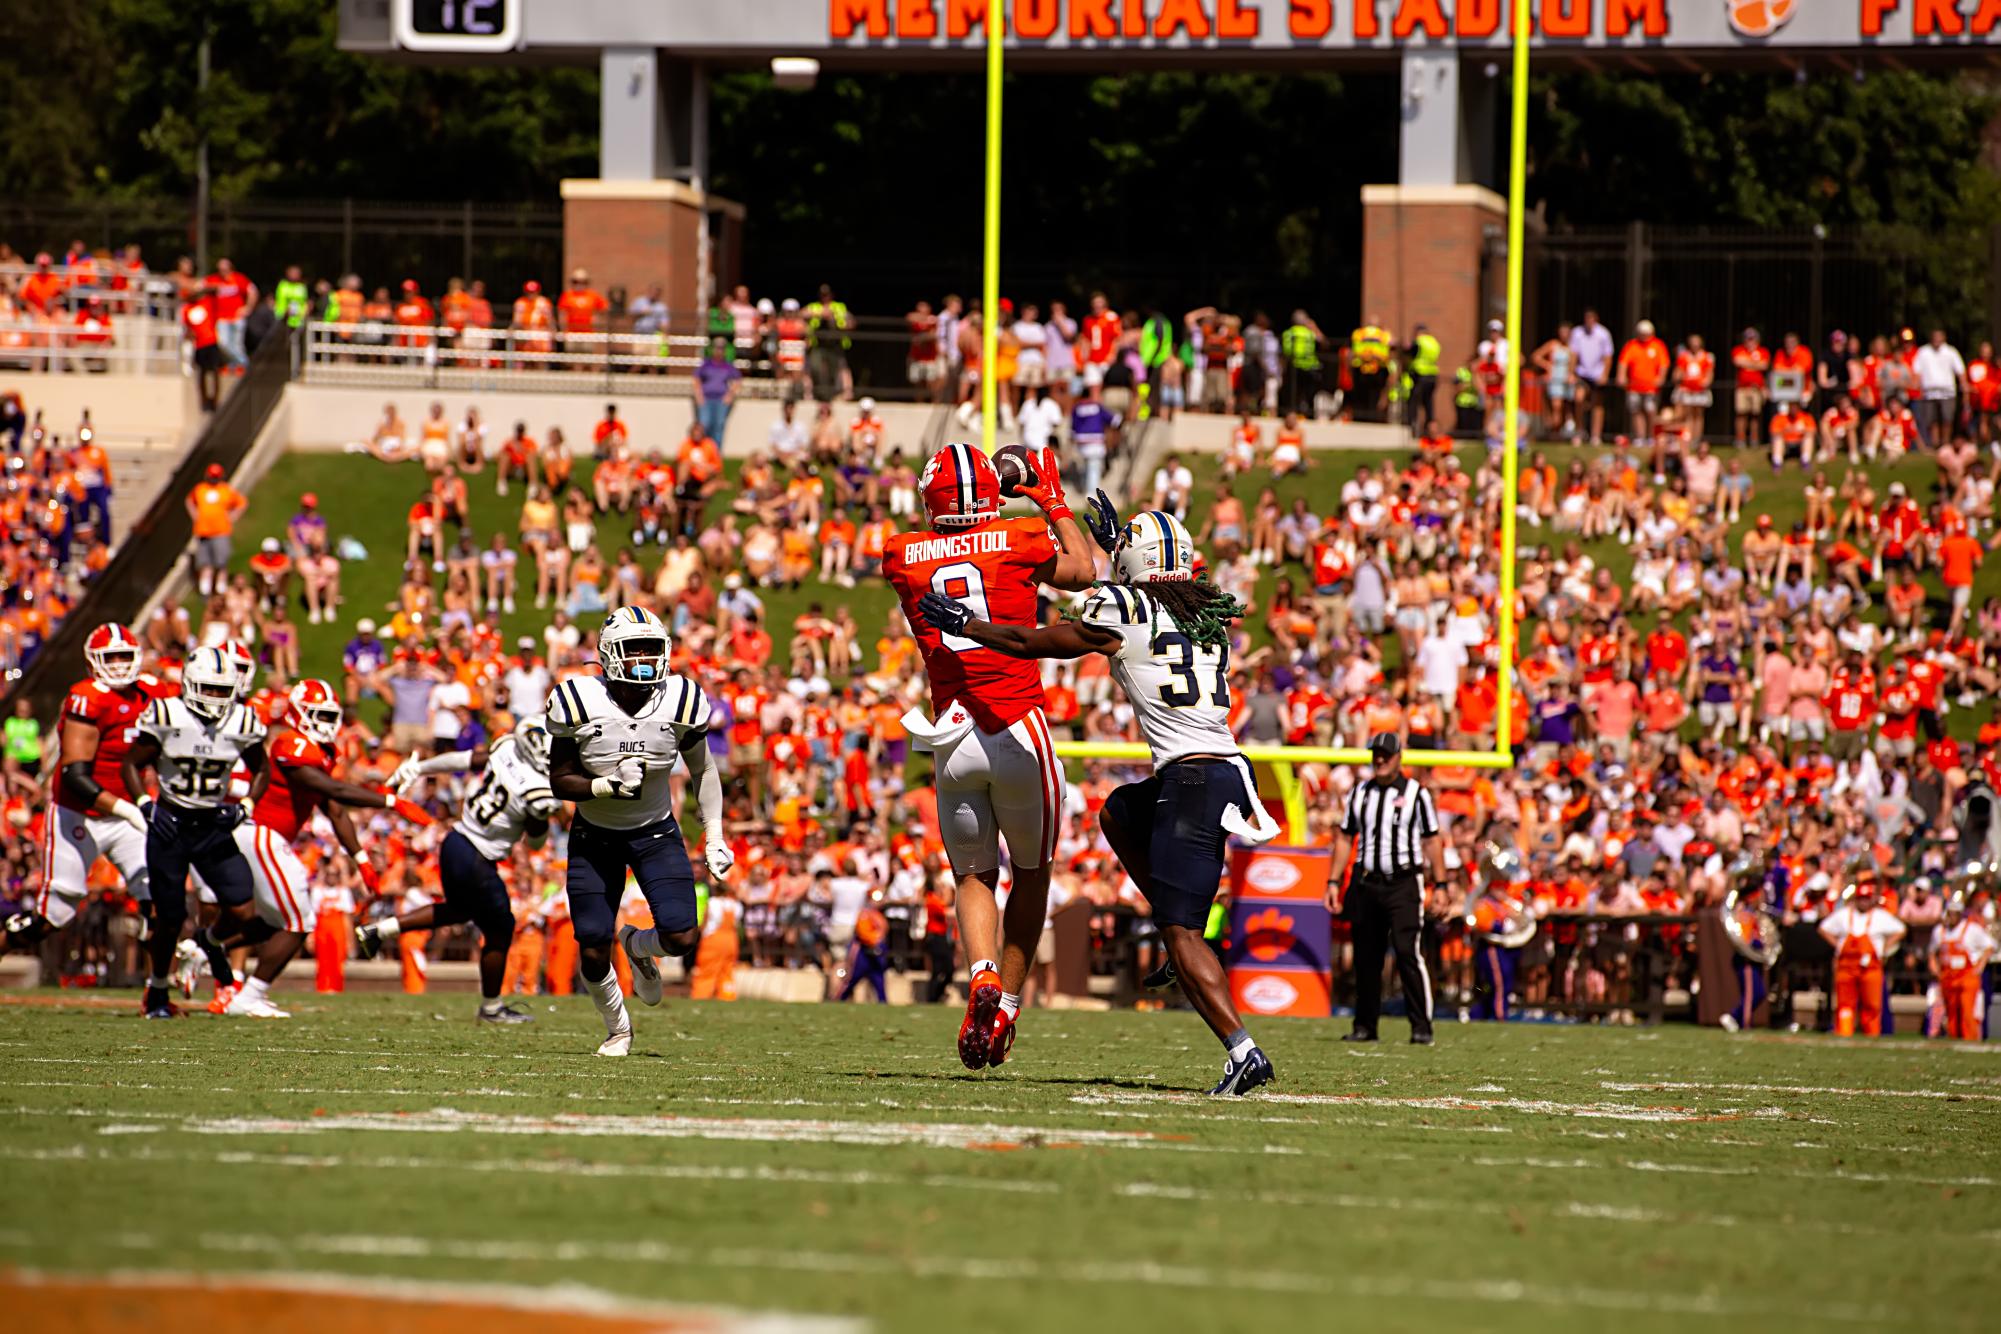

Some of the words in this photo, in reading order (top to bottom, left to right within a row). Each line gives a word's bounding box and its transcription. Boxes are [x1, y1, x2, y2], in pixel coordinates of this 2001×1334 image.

[829, 0, 1258, 38] MEMORIAL
[1288, 0, 1669, 37] STADUM
[905, 530, 1012, 565] BRININGSTOOL
[1149, 572, 1188, 583] Riddell
[930, 561, 992, 652] 9
[1151, 631, 1231, 709] 37
[71, 694, 88, 717] 71
[294, 737, 307, 757] 7
[619, 741, 645, 753] BUCS
[170, 757, 227, 797] 32
